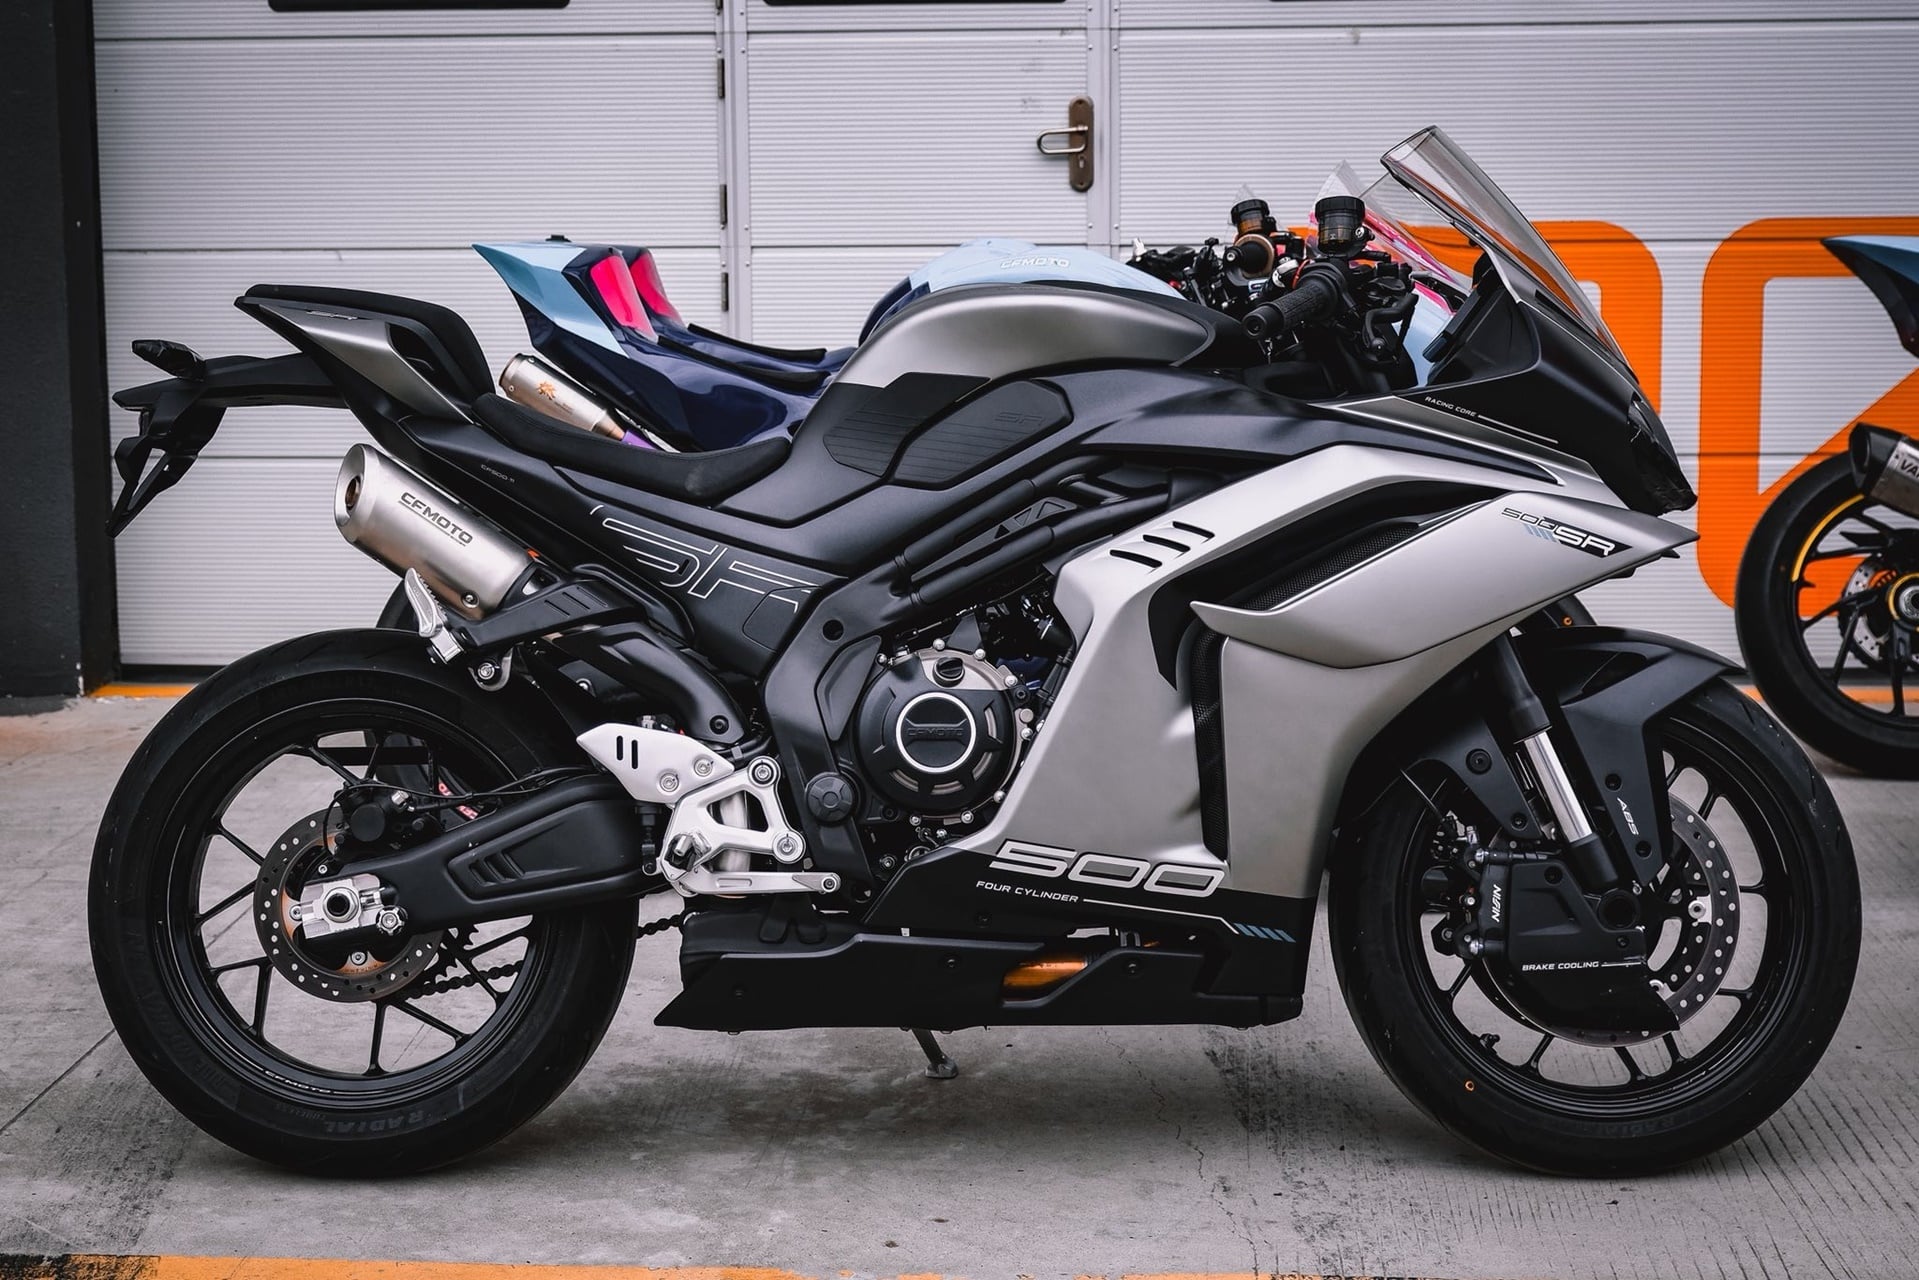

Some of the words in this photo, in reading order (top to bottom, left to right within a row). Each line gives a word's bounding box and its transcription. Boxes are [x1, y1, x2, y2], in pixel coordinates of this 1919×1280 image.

[1425, 396, 1454, 410] RACING
[1455, 406, 1477, 417] CORE
[1901, 459, 1919, 480] VA
[401, 492, 473, 544] CFMOTO
[1616, 796, 1639, 835] ABS
[989, 838, 1225, 898] 500
[976, 880, 1012, 893] FOUR
[1014, 886, 1079, 903] CYLINDER
[1522, 962, 1555, 972] BRAKE
[1557, 960, 1600, 970] COOLING
[323, 1109, 425, 1133] RADIAL
